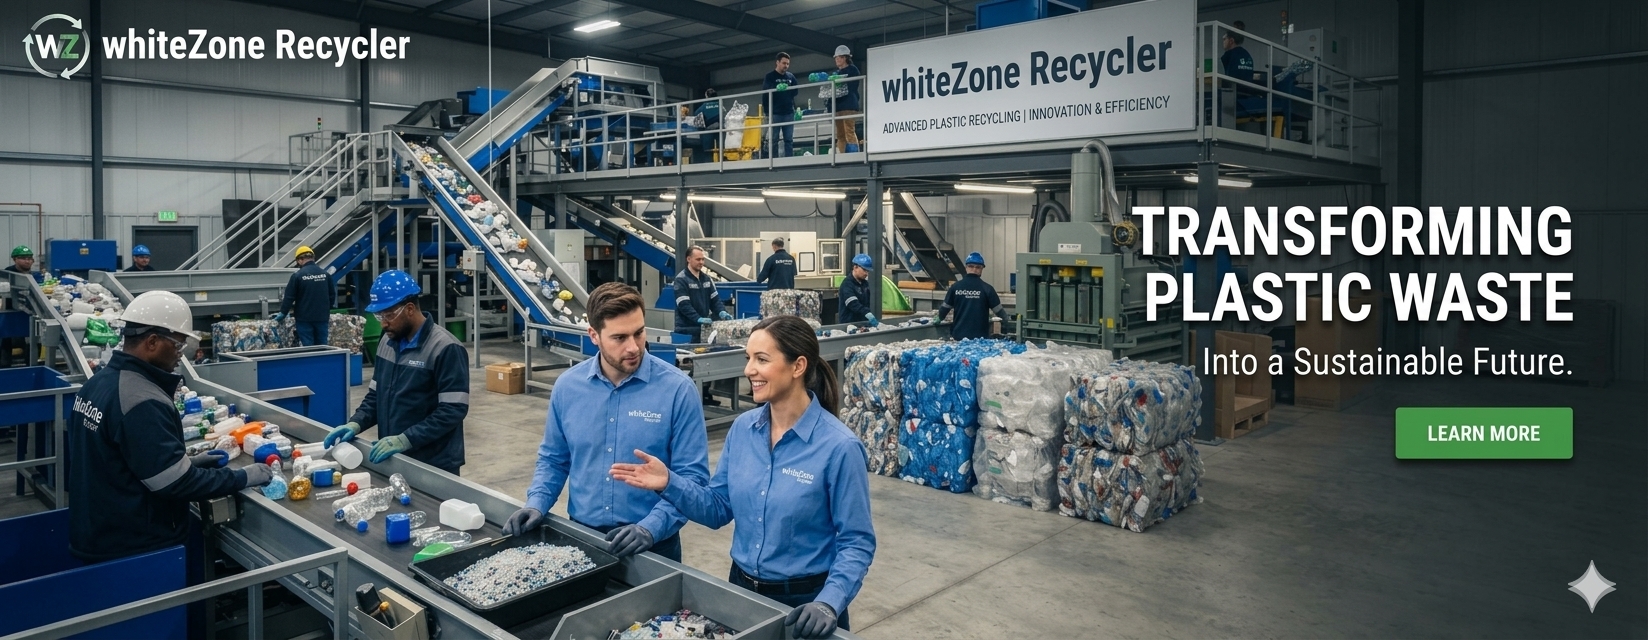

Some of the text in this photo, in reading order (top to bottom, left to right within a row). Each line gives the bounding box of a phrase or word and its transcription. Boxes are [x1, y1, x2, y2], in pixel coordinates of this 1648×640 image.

[882, 35, 1173, 103] whiteZone Recycler
[882, 119, 928, 134] ADVANCED
[929, 115, 967, 130] PLASTIC
[968, 110, 1021, 126] RECYCLING
[1029, 103, 1092, 121] INNOVATION
[1095, 102, 1103, 115] &
[1105, 95, 1171, 114] EFFICIENCY
